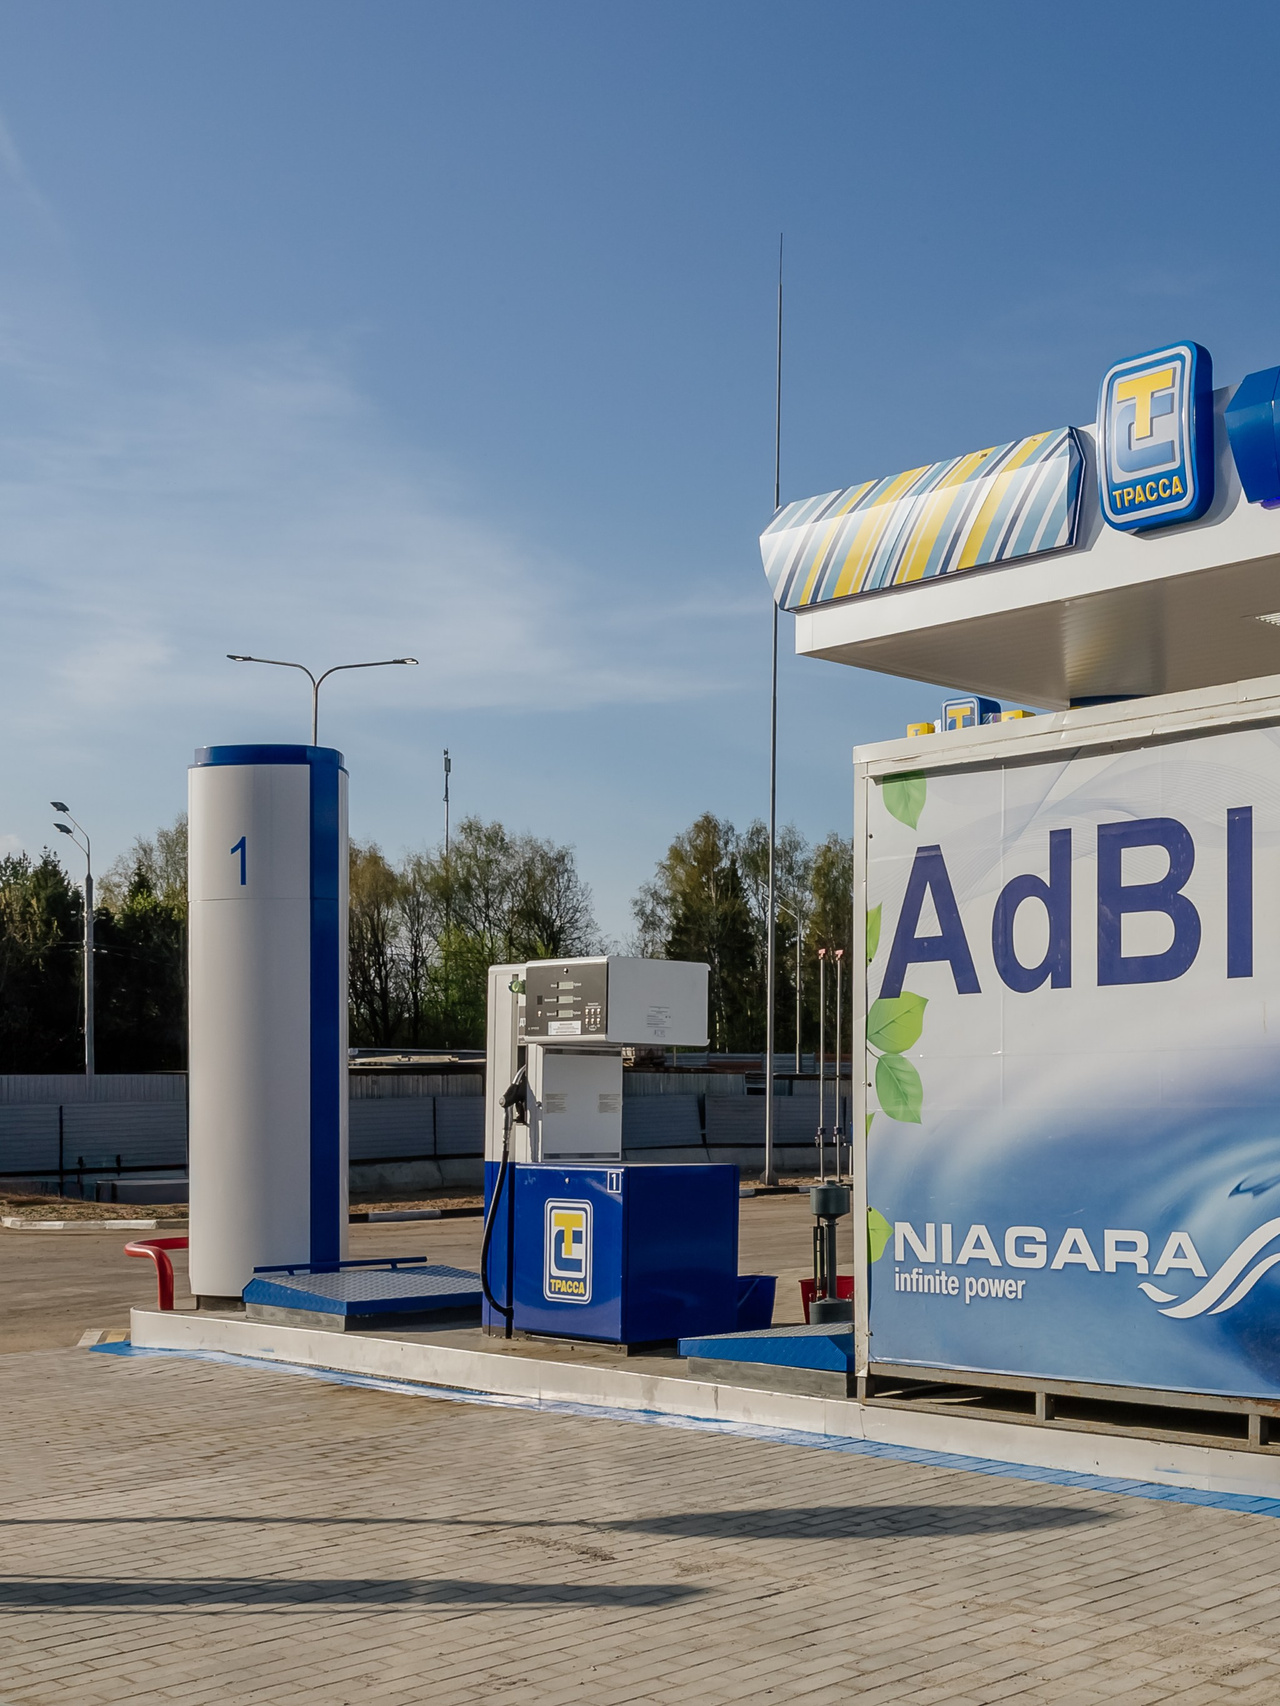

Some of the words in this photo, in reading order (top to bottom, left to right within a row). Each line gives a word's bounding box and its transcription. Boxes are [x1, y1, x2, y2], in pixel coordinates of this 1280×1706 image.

[1112, 475, 1184, 509] ТРАССА
[230, 836, 247, 886] 1
[611, 1173, 618, 1191] 1
[894, 1221, 1208, 1278] NIAGARA
[550, 1279, 585, 1295] ТРАССА
[894, 1267, 960, 1296] infinite
[965, 1273, 1026, 1305] power
